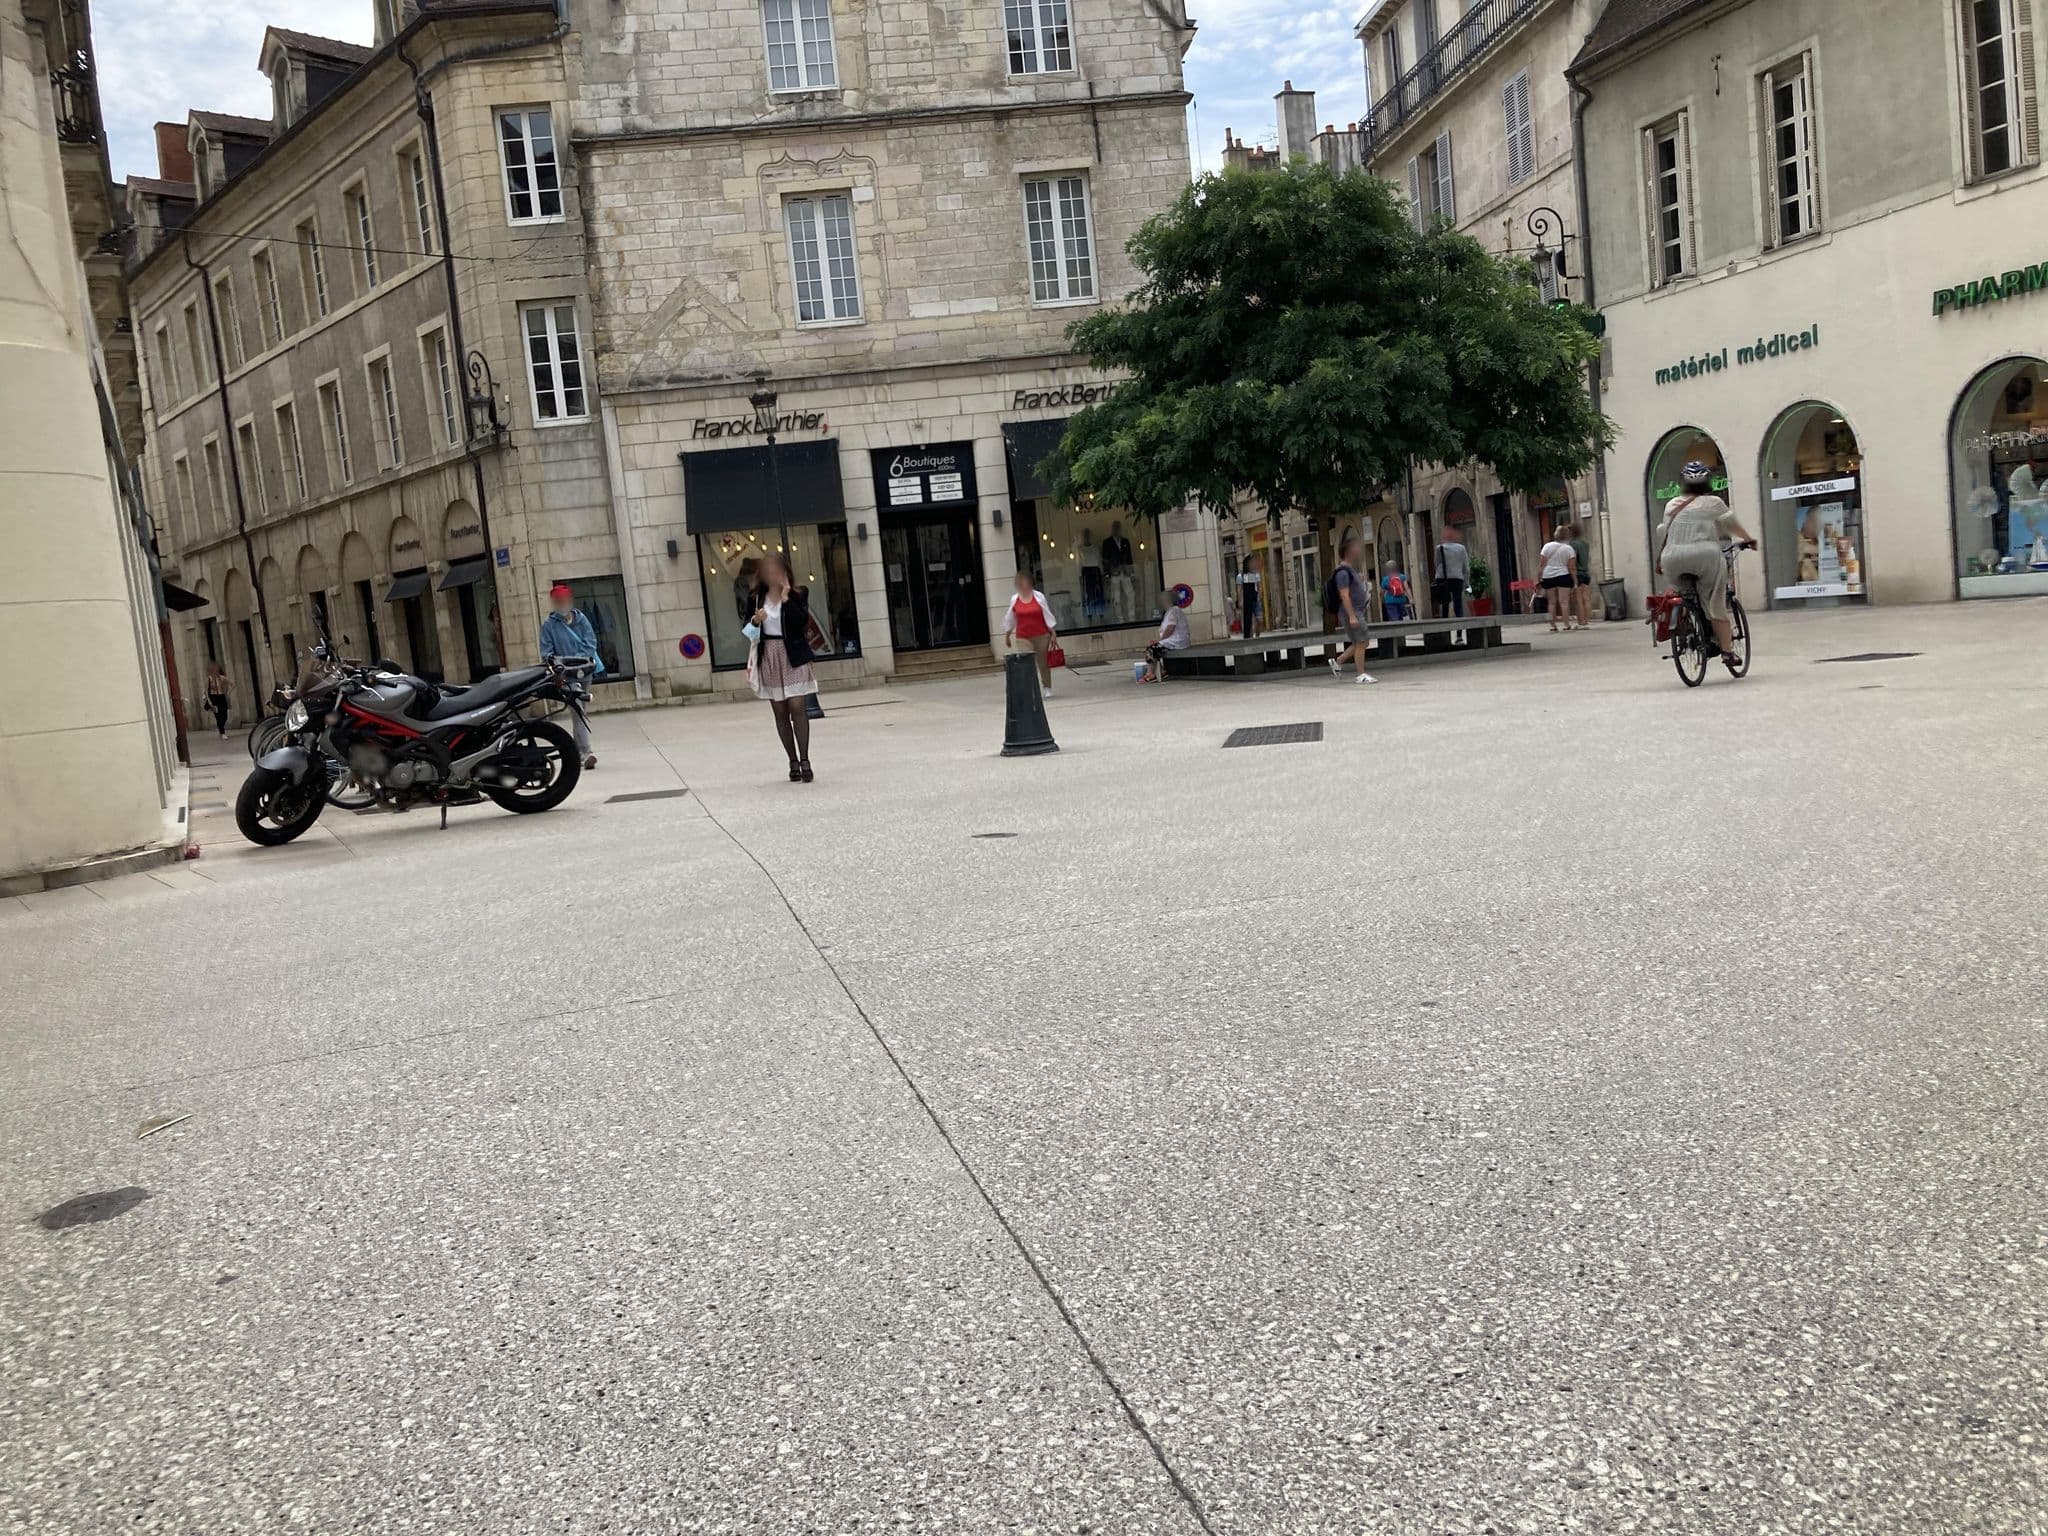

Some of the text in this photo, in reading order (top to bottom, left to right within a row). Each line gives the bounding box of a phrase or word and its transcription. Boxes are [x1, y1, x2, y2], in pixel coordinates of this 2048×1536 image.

[1655, 323, 1819, 386] matériel médical
[1013, 381, 1118, 410] Franck Berth
[692, 415, 752, 440] Franck
[890, 455, 956, 477] 6 Boutiques
[1788, 482, 1836, 496] CAPITAL SOLEIL
